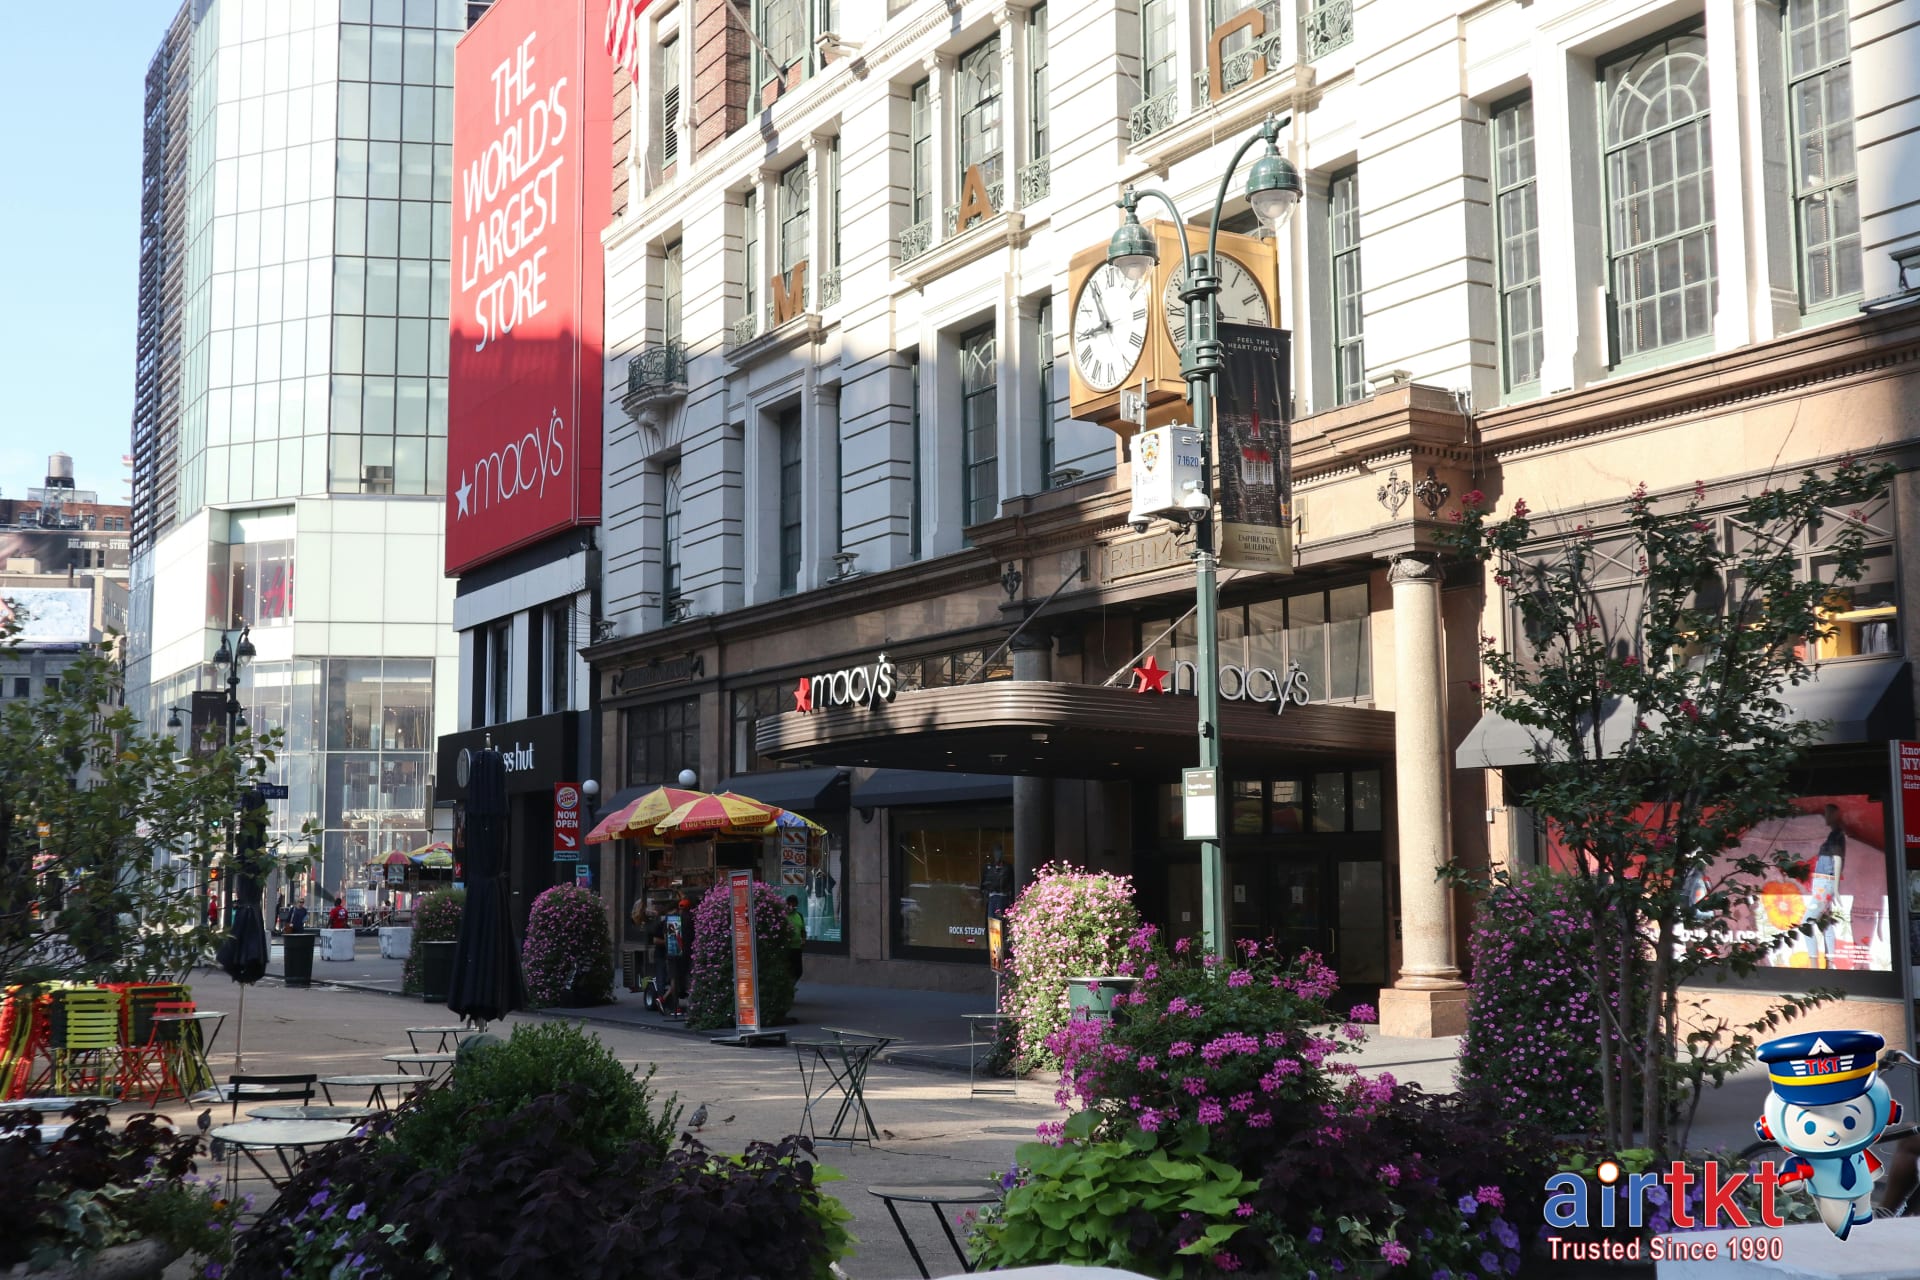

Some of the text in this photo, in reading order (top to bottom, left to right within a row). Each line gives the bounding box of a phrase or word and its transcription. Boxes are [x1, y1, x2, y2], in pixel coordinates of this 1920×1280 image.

[490, 31, 536, 126] THE
[463, 77, 567, 222] WORLD'S
[956, 163, 993, 235] A
[462, 156, 564, 292] LARGEST
[475, 246, 547, 352] STORE
[771, 260, 806, 325] M
[1227, 342, 1250, 350] HEART
[1236, 336, 1270, 346] FEEL THE
[474, 407, 564, 515] macy's
[1177, 455, 1199, 468] 71620
[1238, 534, 1259, 543] EMPIRE
[1243, 543, 1274, 552] BUILDING
[811, 652, 891, 712] macy's
[515, 741, 535, 771] hut
[555, 820, 578, 828] OPEN
[557, 811, 577, 819] NOW
[949, 926, 986, 936] ROCK STEADY
